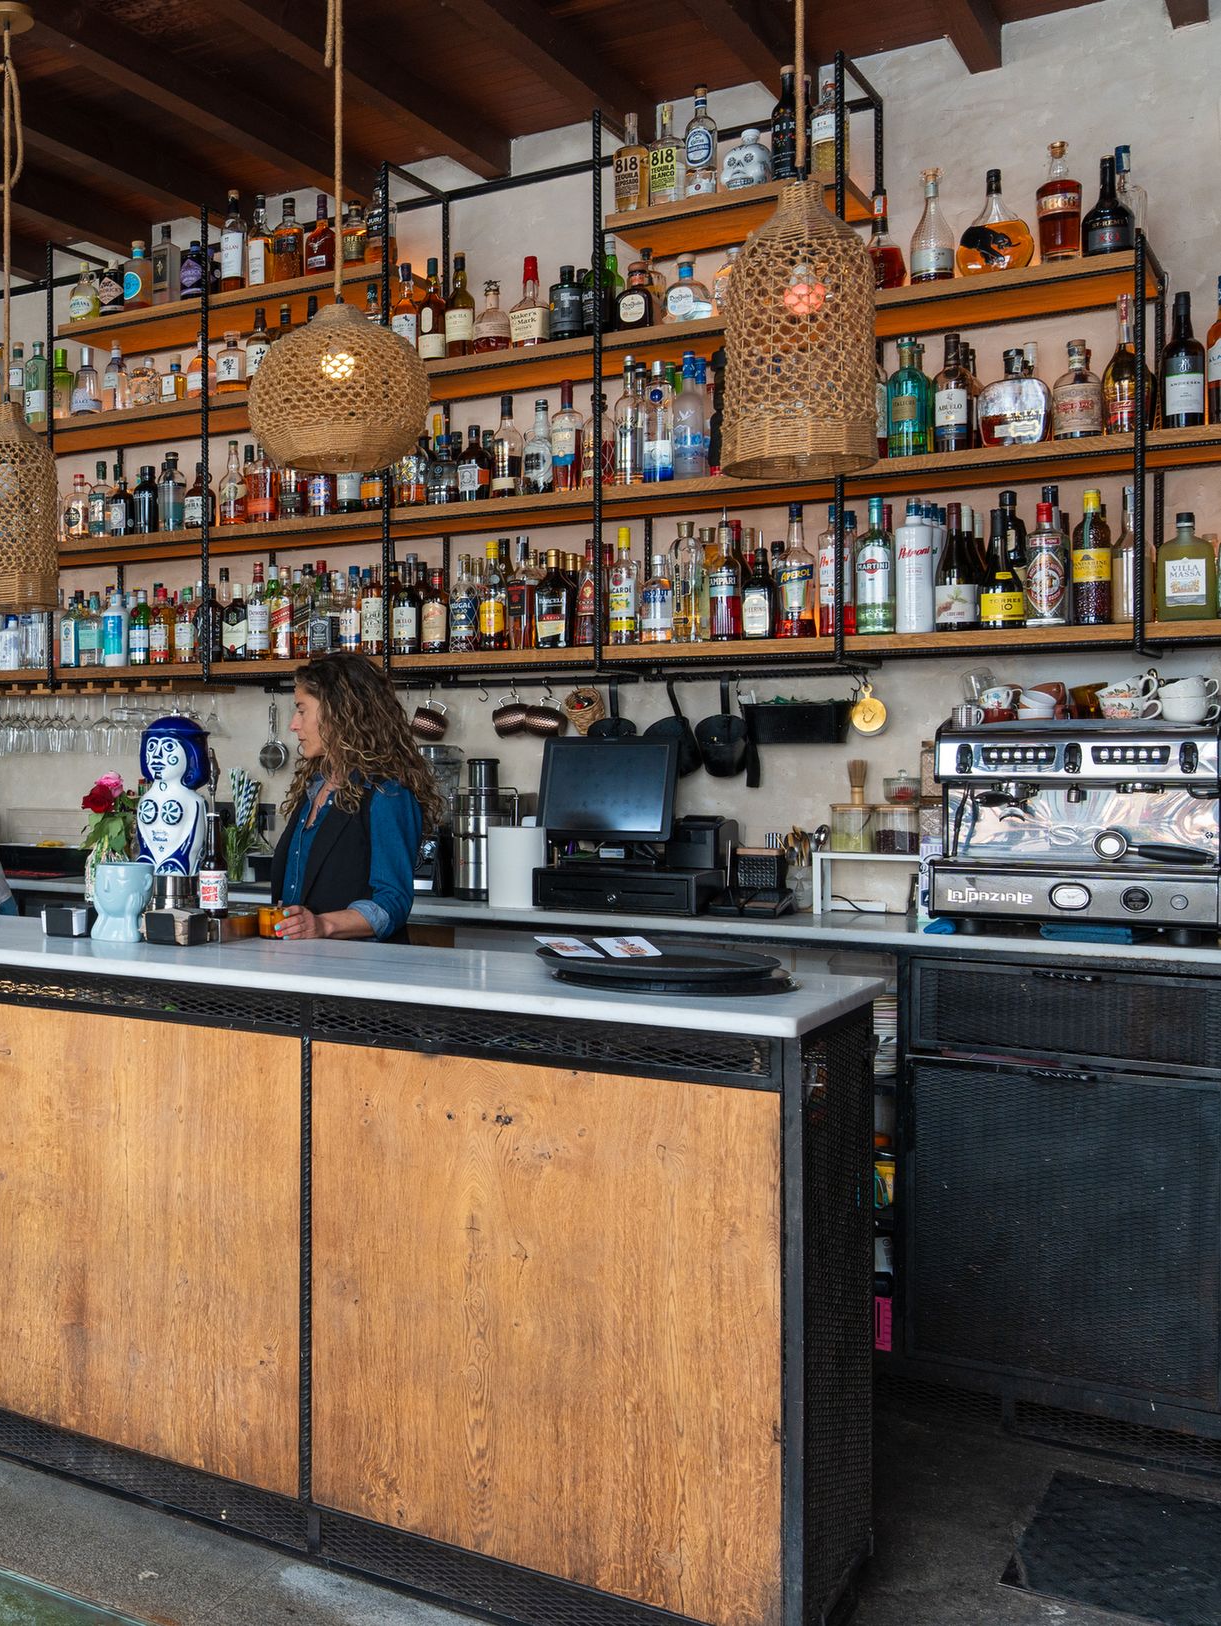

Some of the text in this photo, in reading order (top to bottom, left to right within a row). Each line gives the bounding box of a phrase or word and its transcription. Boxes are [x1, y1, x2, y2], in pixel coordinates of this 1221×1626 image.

[651, 149, 674, 166] 818
[615, 157, 638, 173] 818
[652, 164, 674, 174] TEQUILA
[615, 171, 638, 180] TEQUILA
[652, 171, 675, 180] BLANCO
[511, 311, 537, 320] Maker's
[858, 562, 888, 570] MARTINI
[781, 568, 810, 582] APEROL
[711, 577, 736, 585] AMPARI
